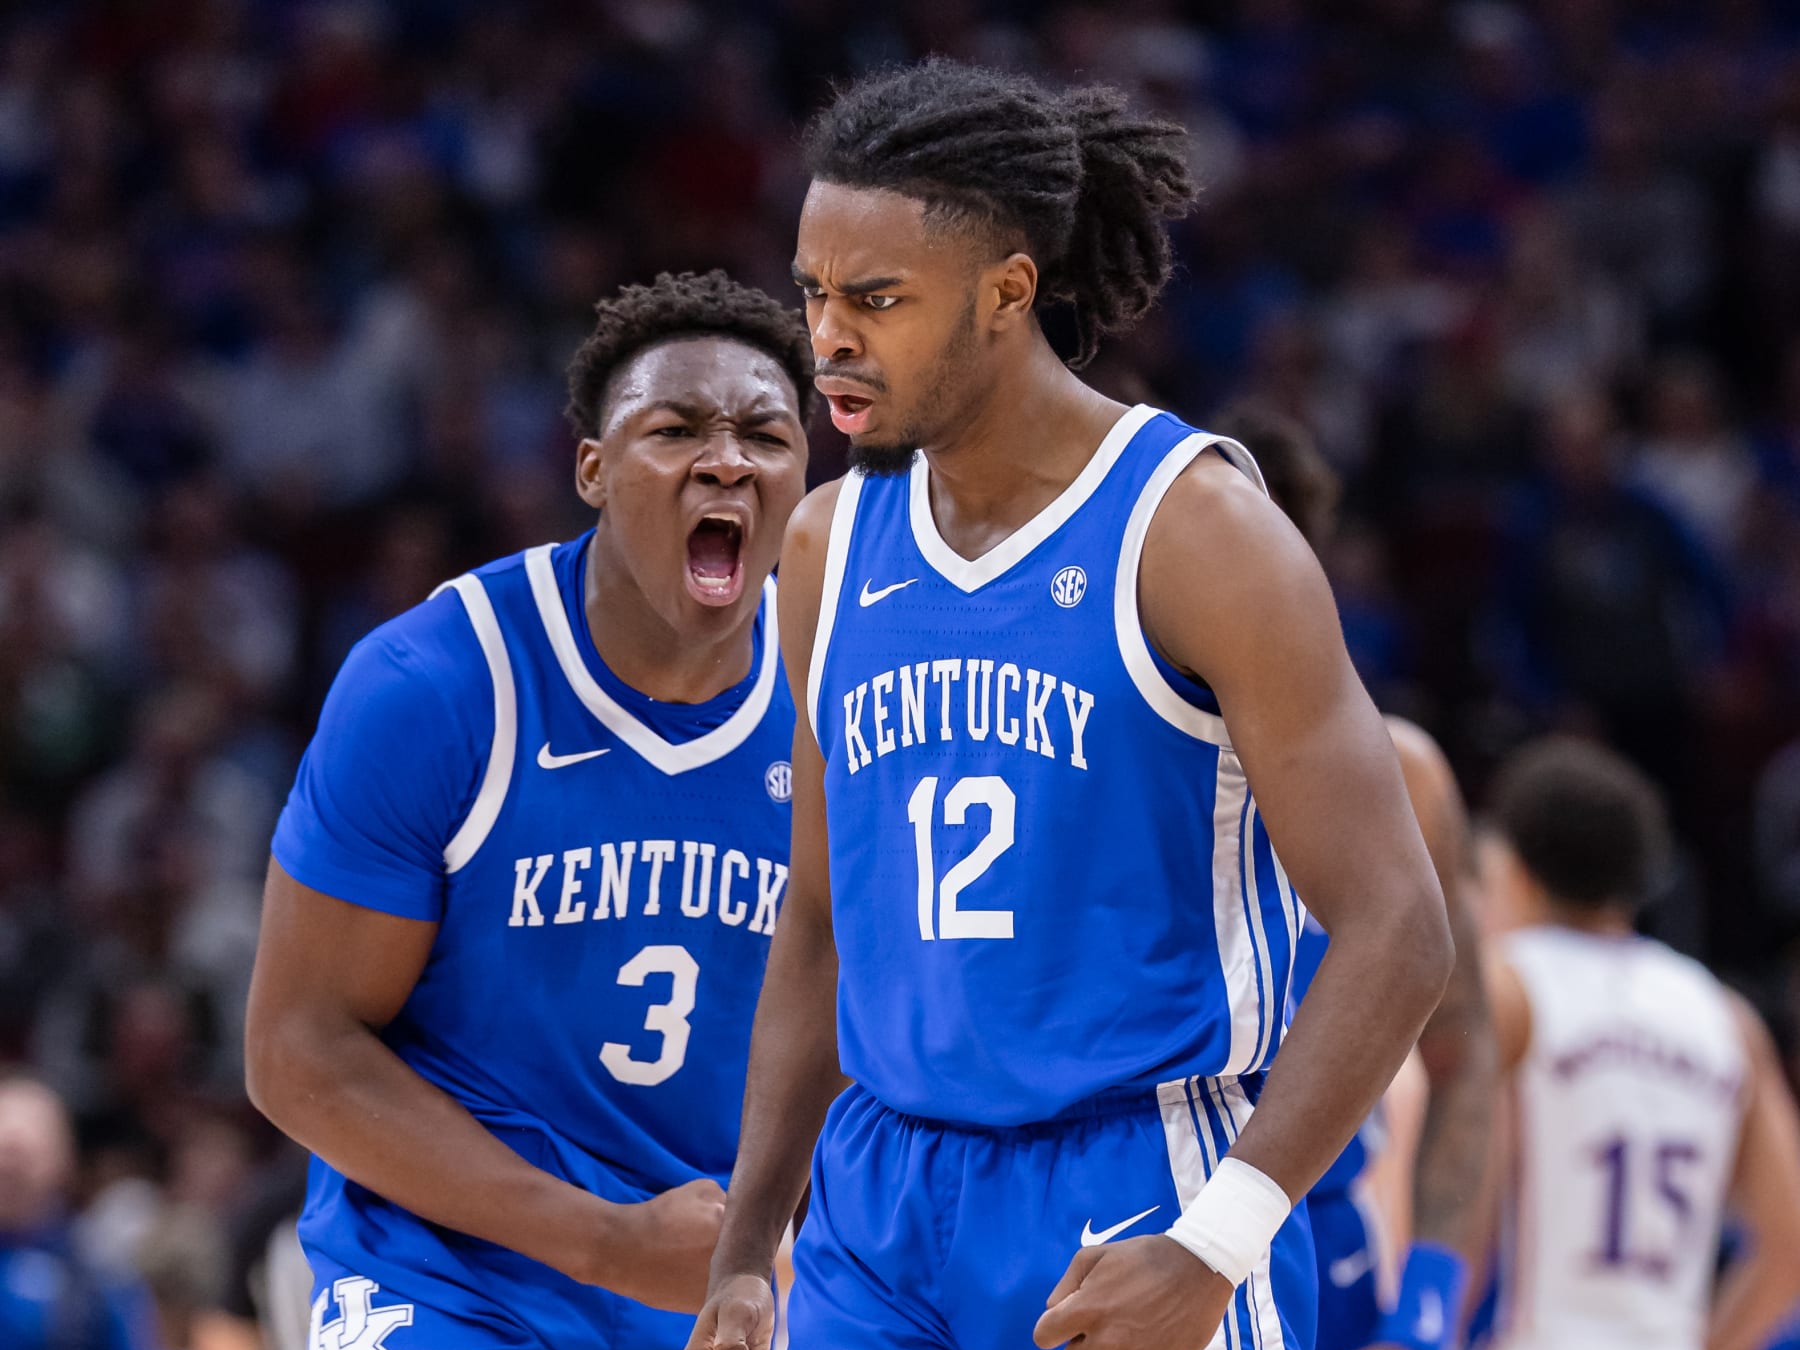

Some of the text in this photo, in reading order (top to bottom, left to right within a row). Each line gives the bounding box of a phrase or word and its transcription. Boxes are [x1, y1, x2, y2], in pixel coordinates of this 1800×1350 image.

[1055, 569, 1084, 604] SEC
[843, 658, 1094, 775] KENTUCKY
[508, 839, 789, 935] KENTUCK
[907, 775, 1016, 941] 12
[599, 944, 700, 1086] 3
[1586, 1133, 1702, 1282] 15
